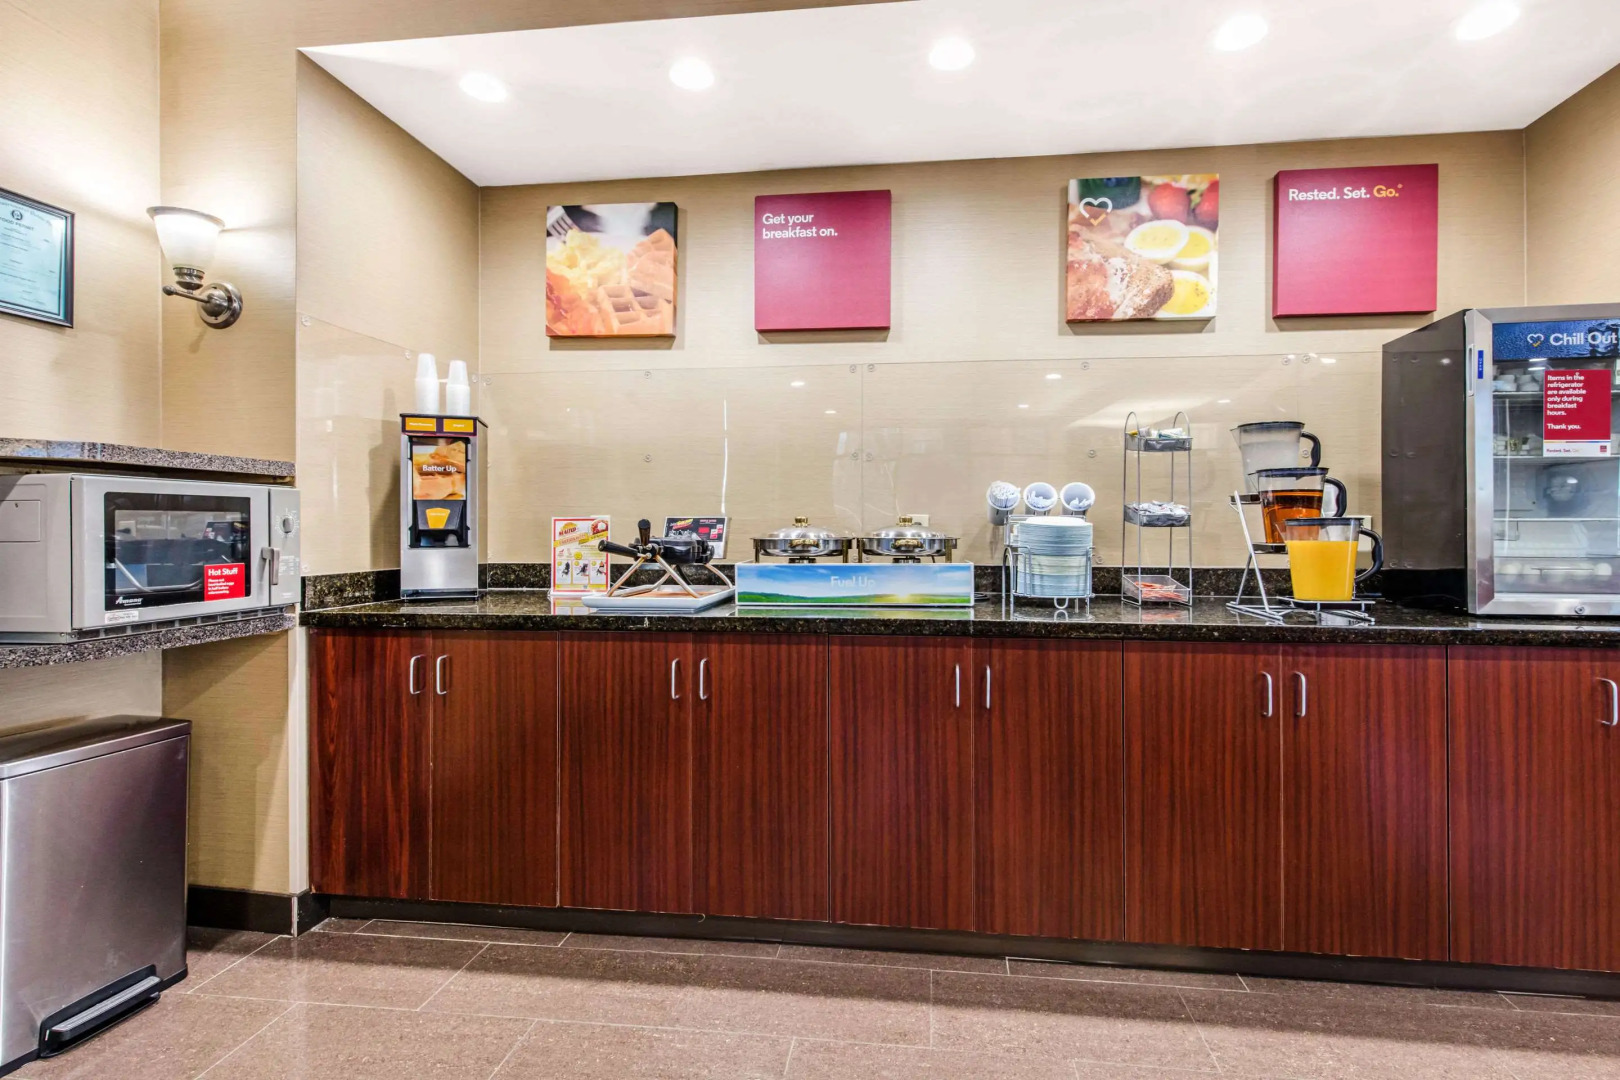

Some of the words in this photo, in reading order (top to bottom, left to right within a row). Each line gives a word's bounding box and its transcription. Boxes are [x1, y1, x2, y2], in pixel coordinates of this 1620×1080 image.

[1288, 187, 1340, 201] Rested.
[1343, 186, 1370, 199] Set.
[762, 213, 786, 225] Get
[788, 213, 814, 226] your
[762, 227, 817, 239] breakfast
[819, 228, 838, 237] on.
[1549, 332, 1584, 346] Chill
[1587, 331, 1618, 345] Out
[422, 464, 444, 472] Batter
[445, 465, 457, 473] Up
[208, 568, 221, 576] Hot
[222, 567, 238, 575] Stuff
[830, 576, 855, 588] Fuel
[858, 576, 876, 590] Up
